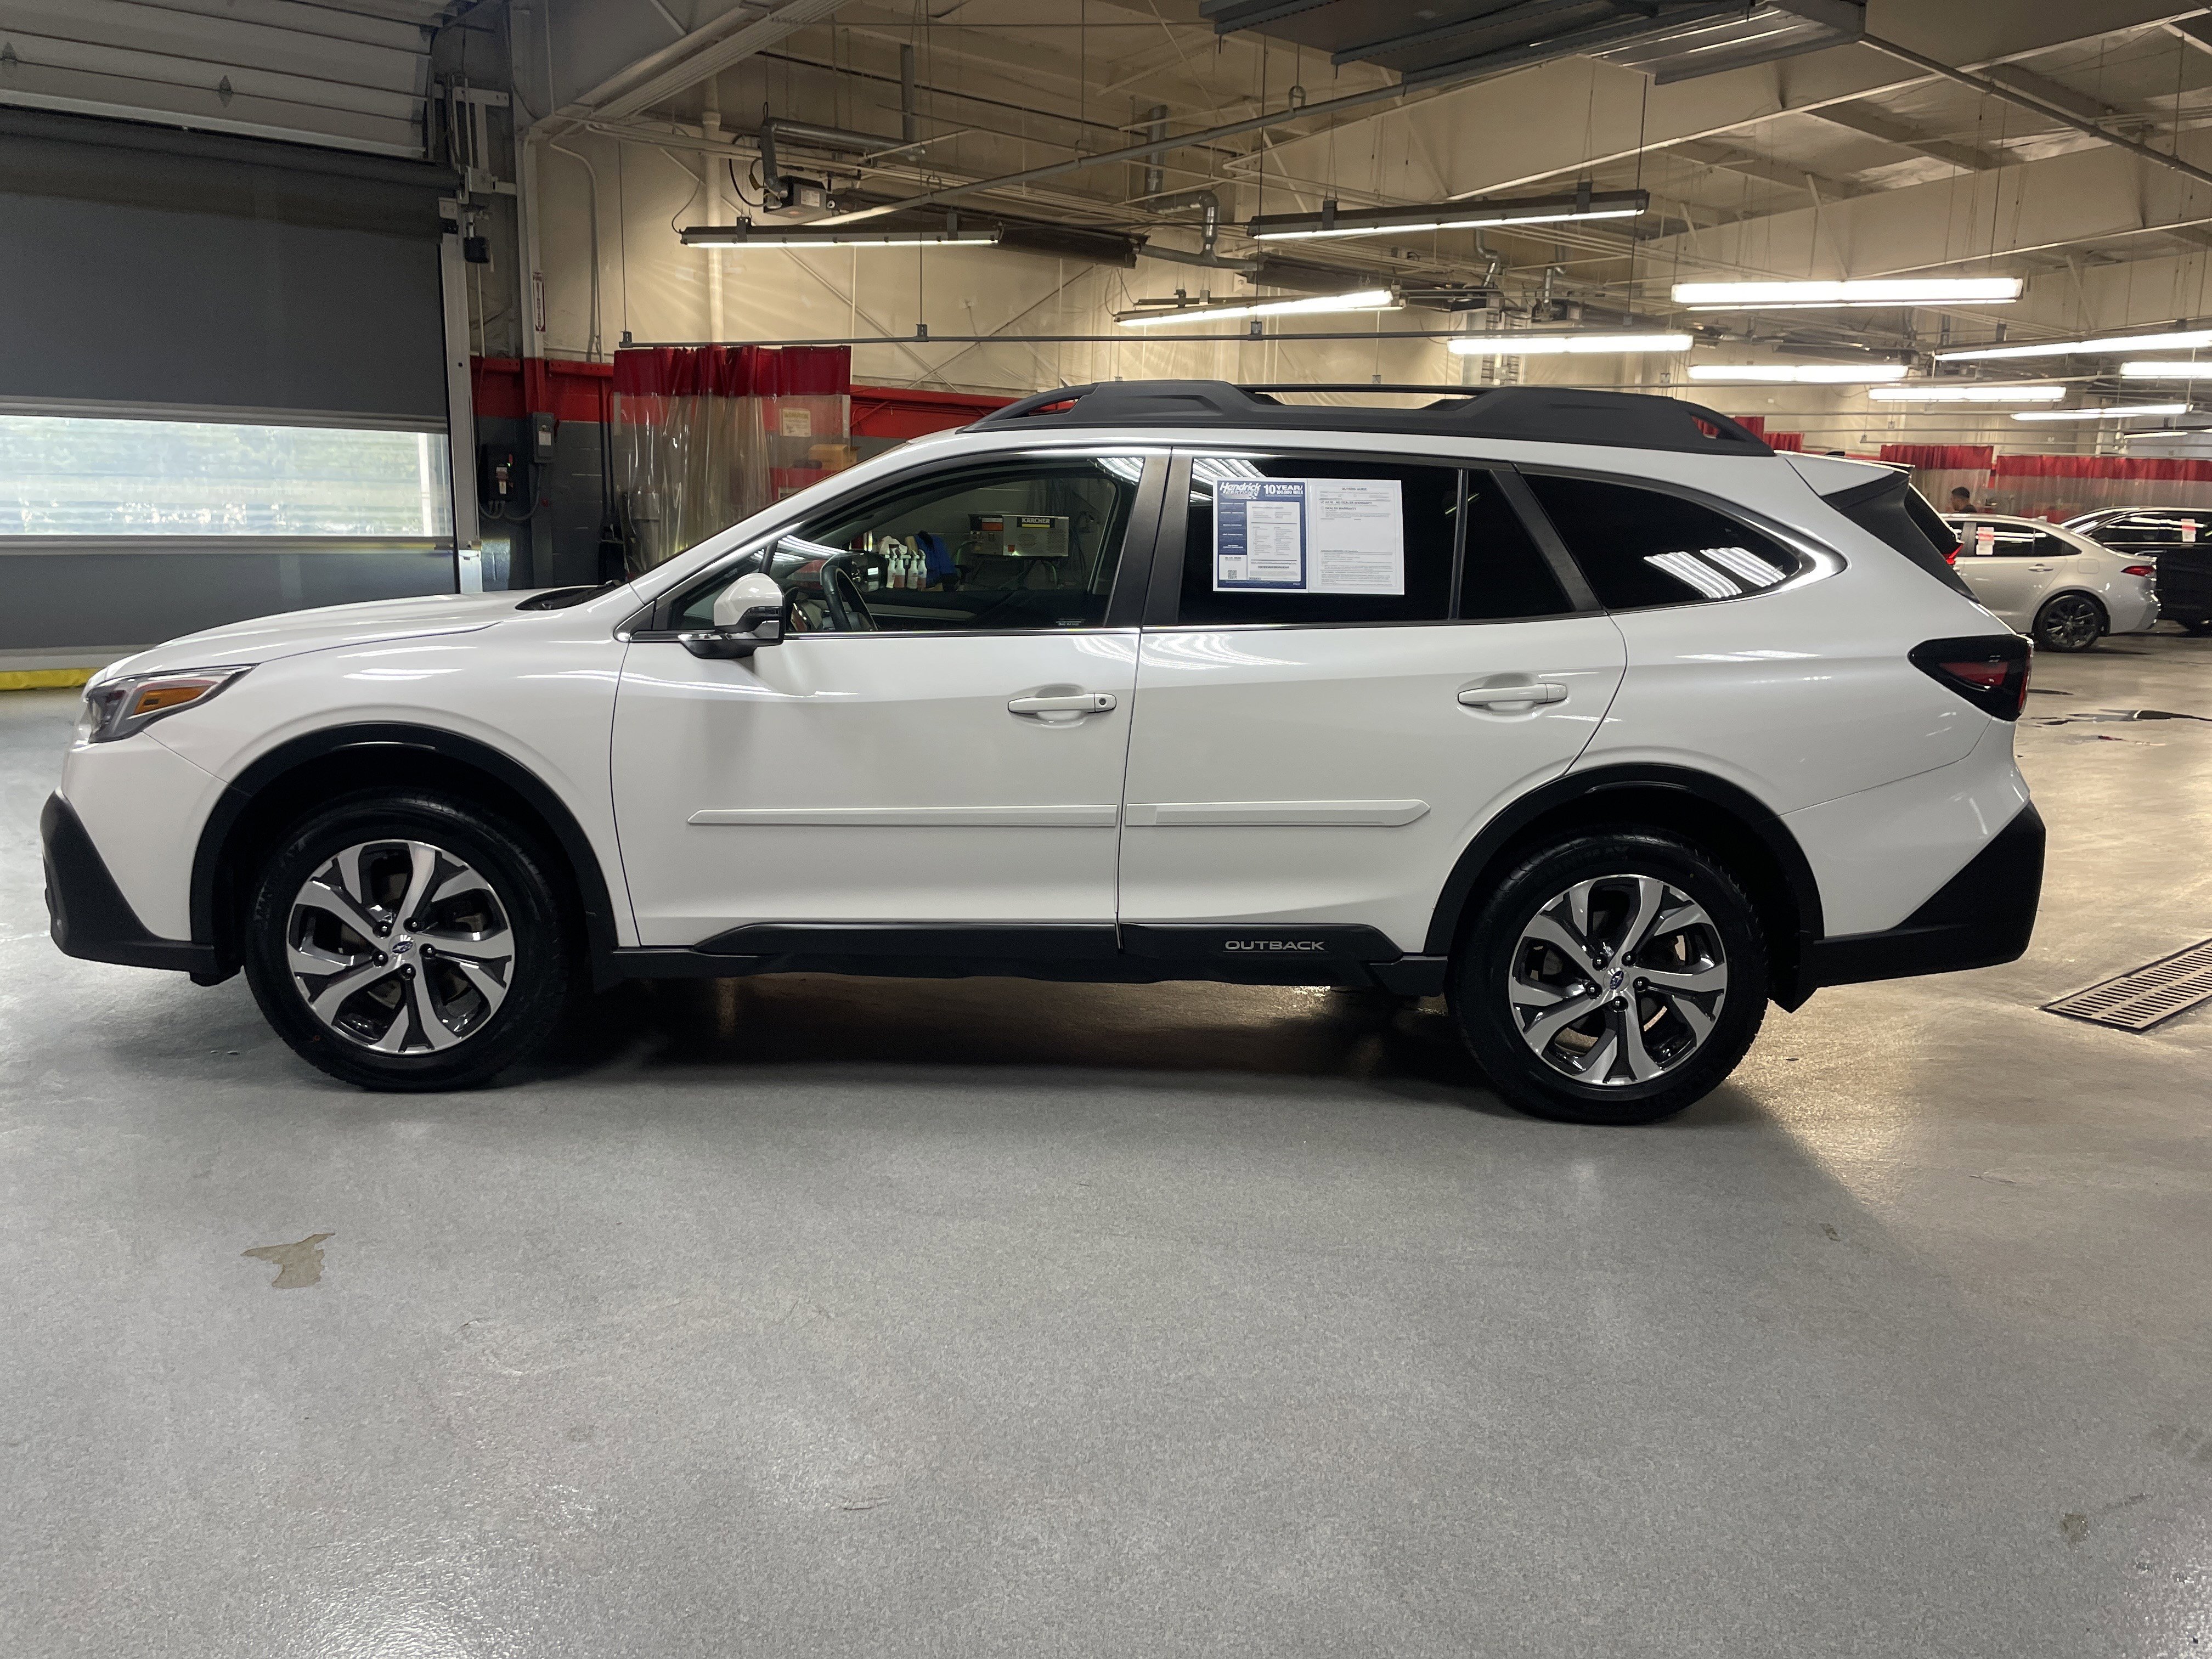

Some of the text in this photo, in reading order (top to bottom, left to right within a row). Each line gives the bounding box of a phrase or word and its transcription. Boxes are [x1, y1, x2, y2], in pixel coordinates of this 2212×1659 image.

[1220, 482, 1261, 493] Hendrick
[1263, 484, 1276, 494] 10
[1224, 940, 1325, 950] OUTBACK
